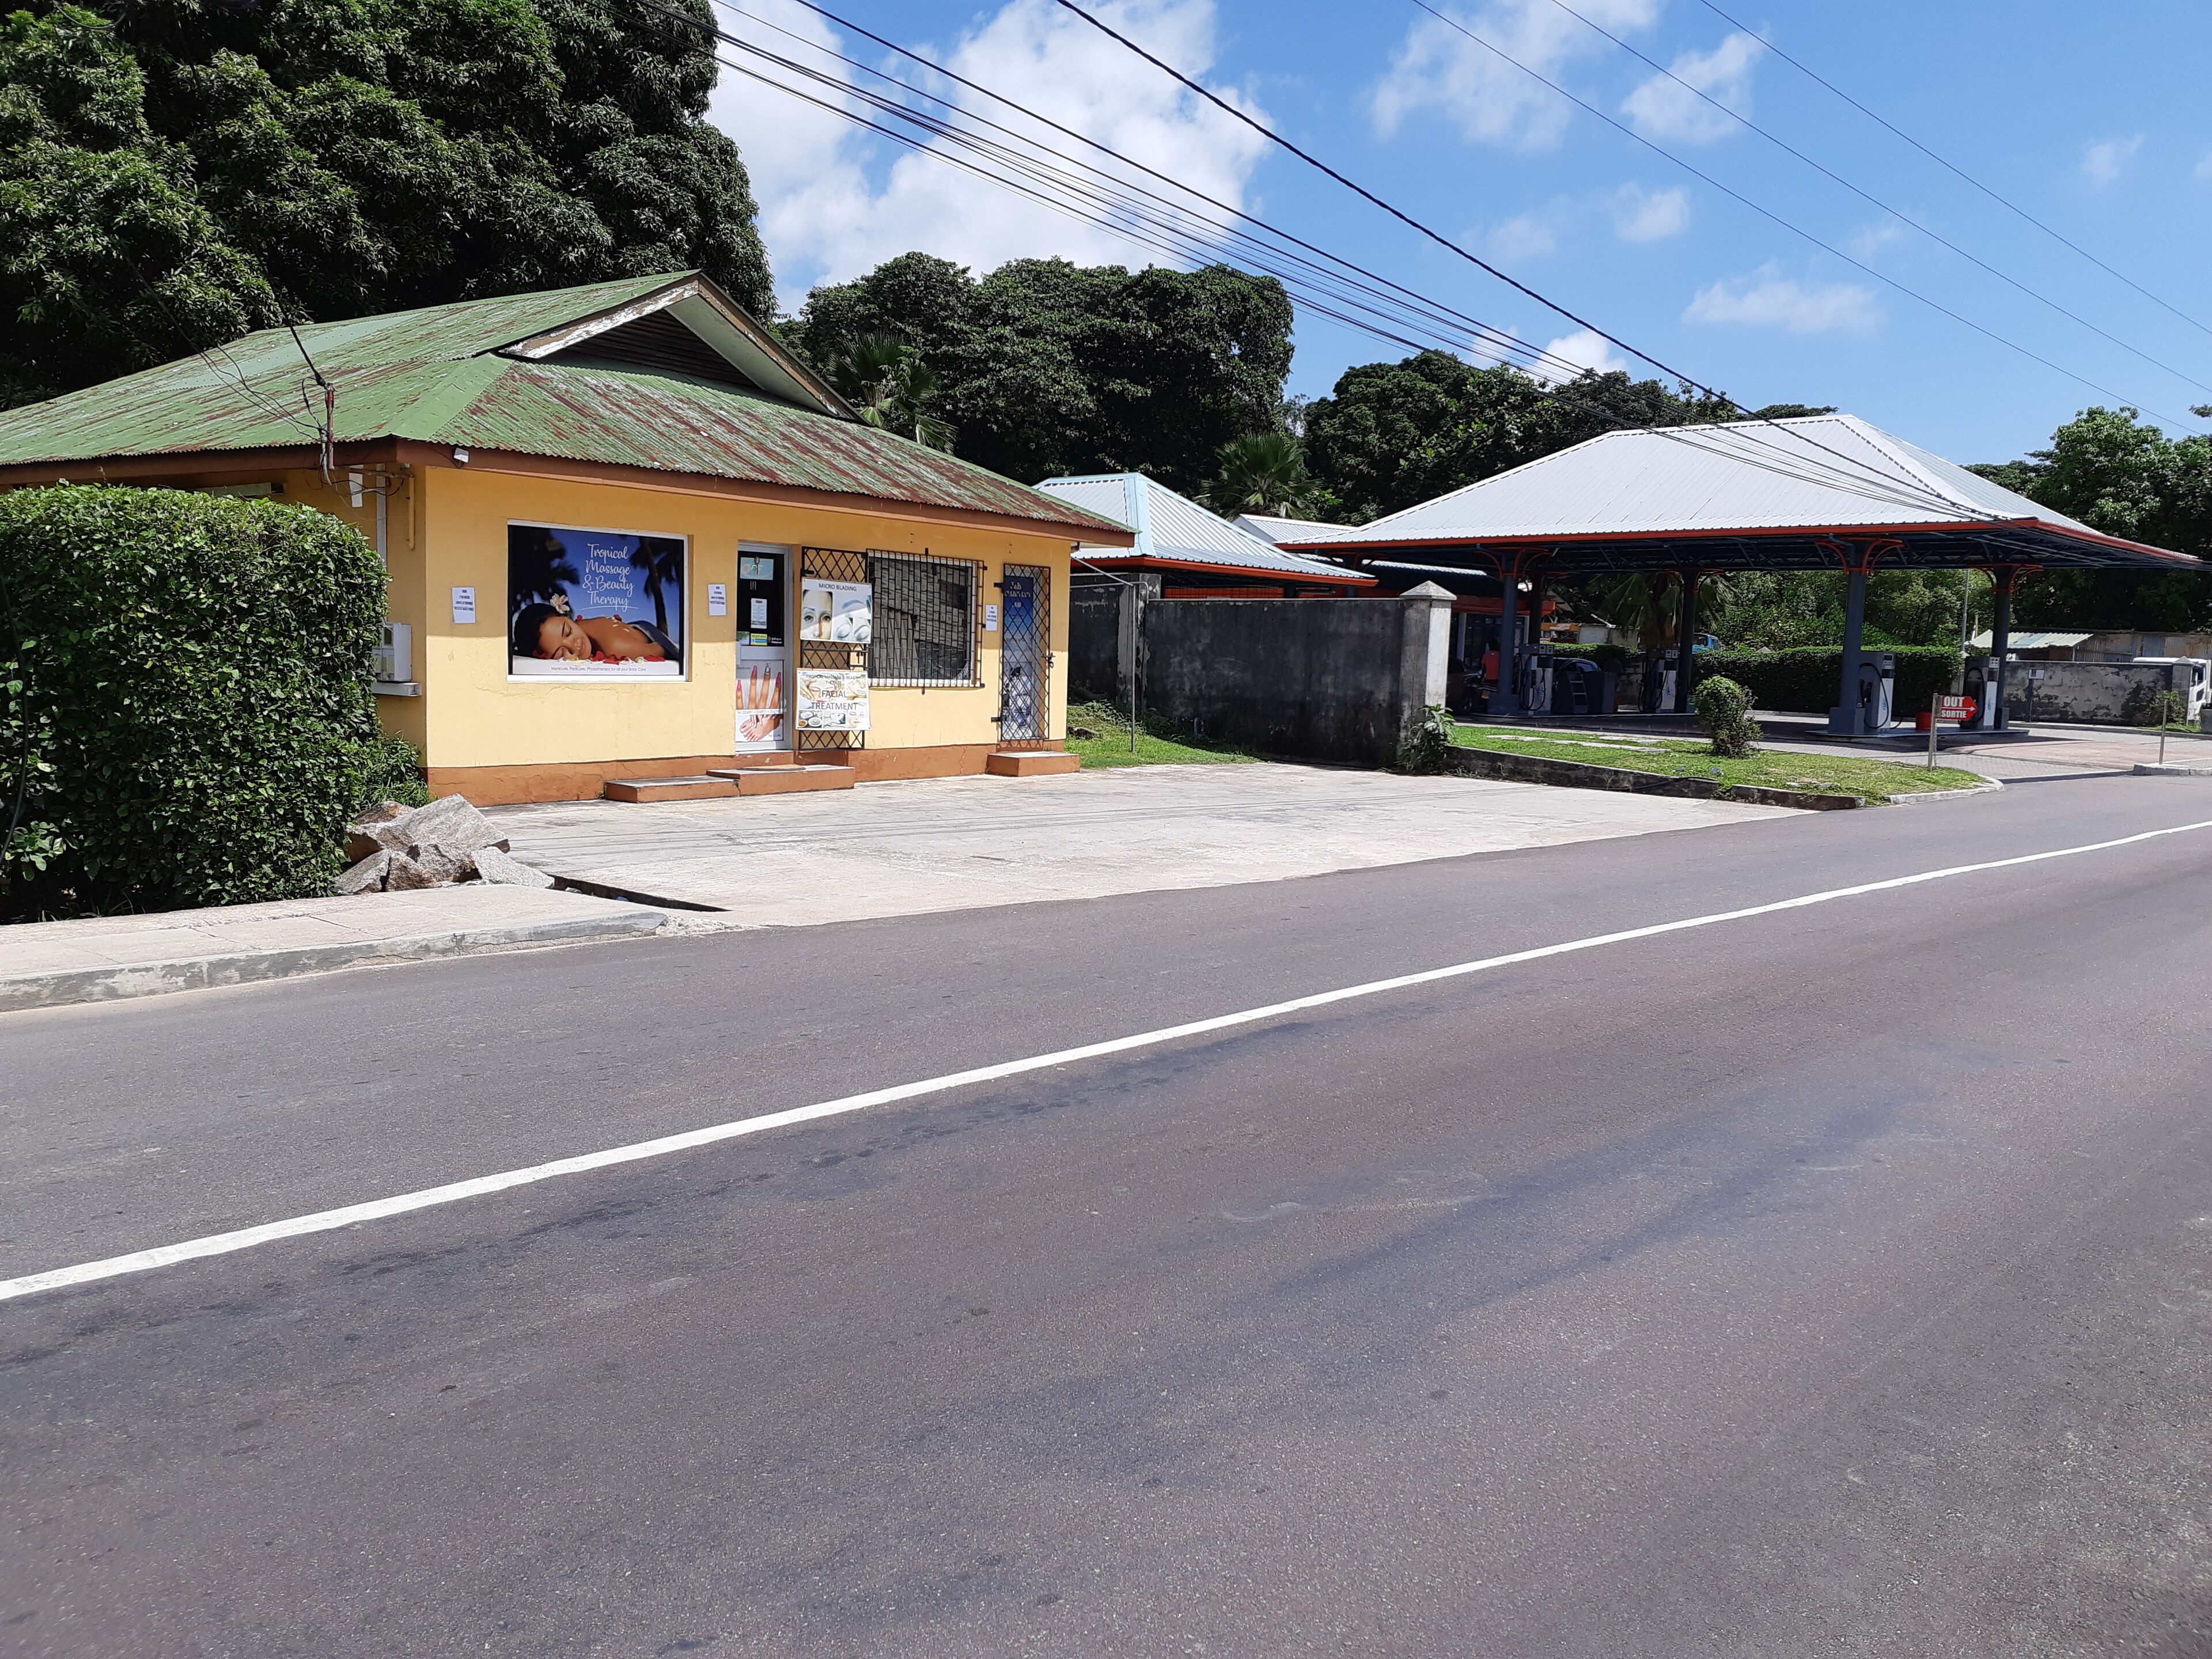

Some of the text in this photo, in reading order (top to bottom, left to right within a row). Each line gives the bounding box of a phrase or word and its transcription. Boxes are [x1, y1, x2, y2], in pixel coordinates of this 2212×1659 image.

[587, 543, 628, 564] Tropical
[585, 559, 631, 582] Massage
[582, 574, 635, 597] & Beauty
[587, 590, 630, 612] Therapy
[1944, 696, 1965, 707] OUT
[1941, 710, 1967, 718] SORTIE
